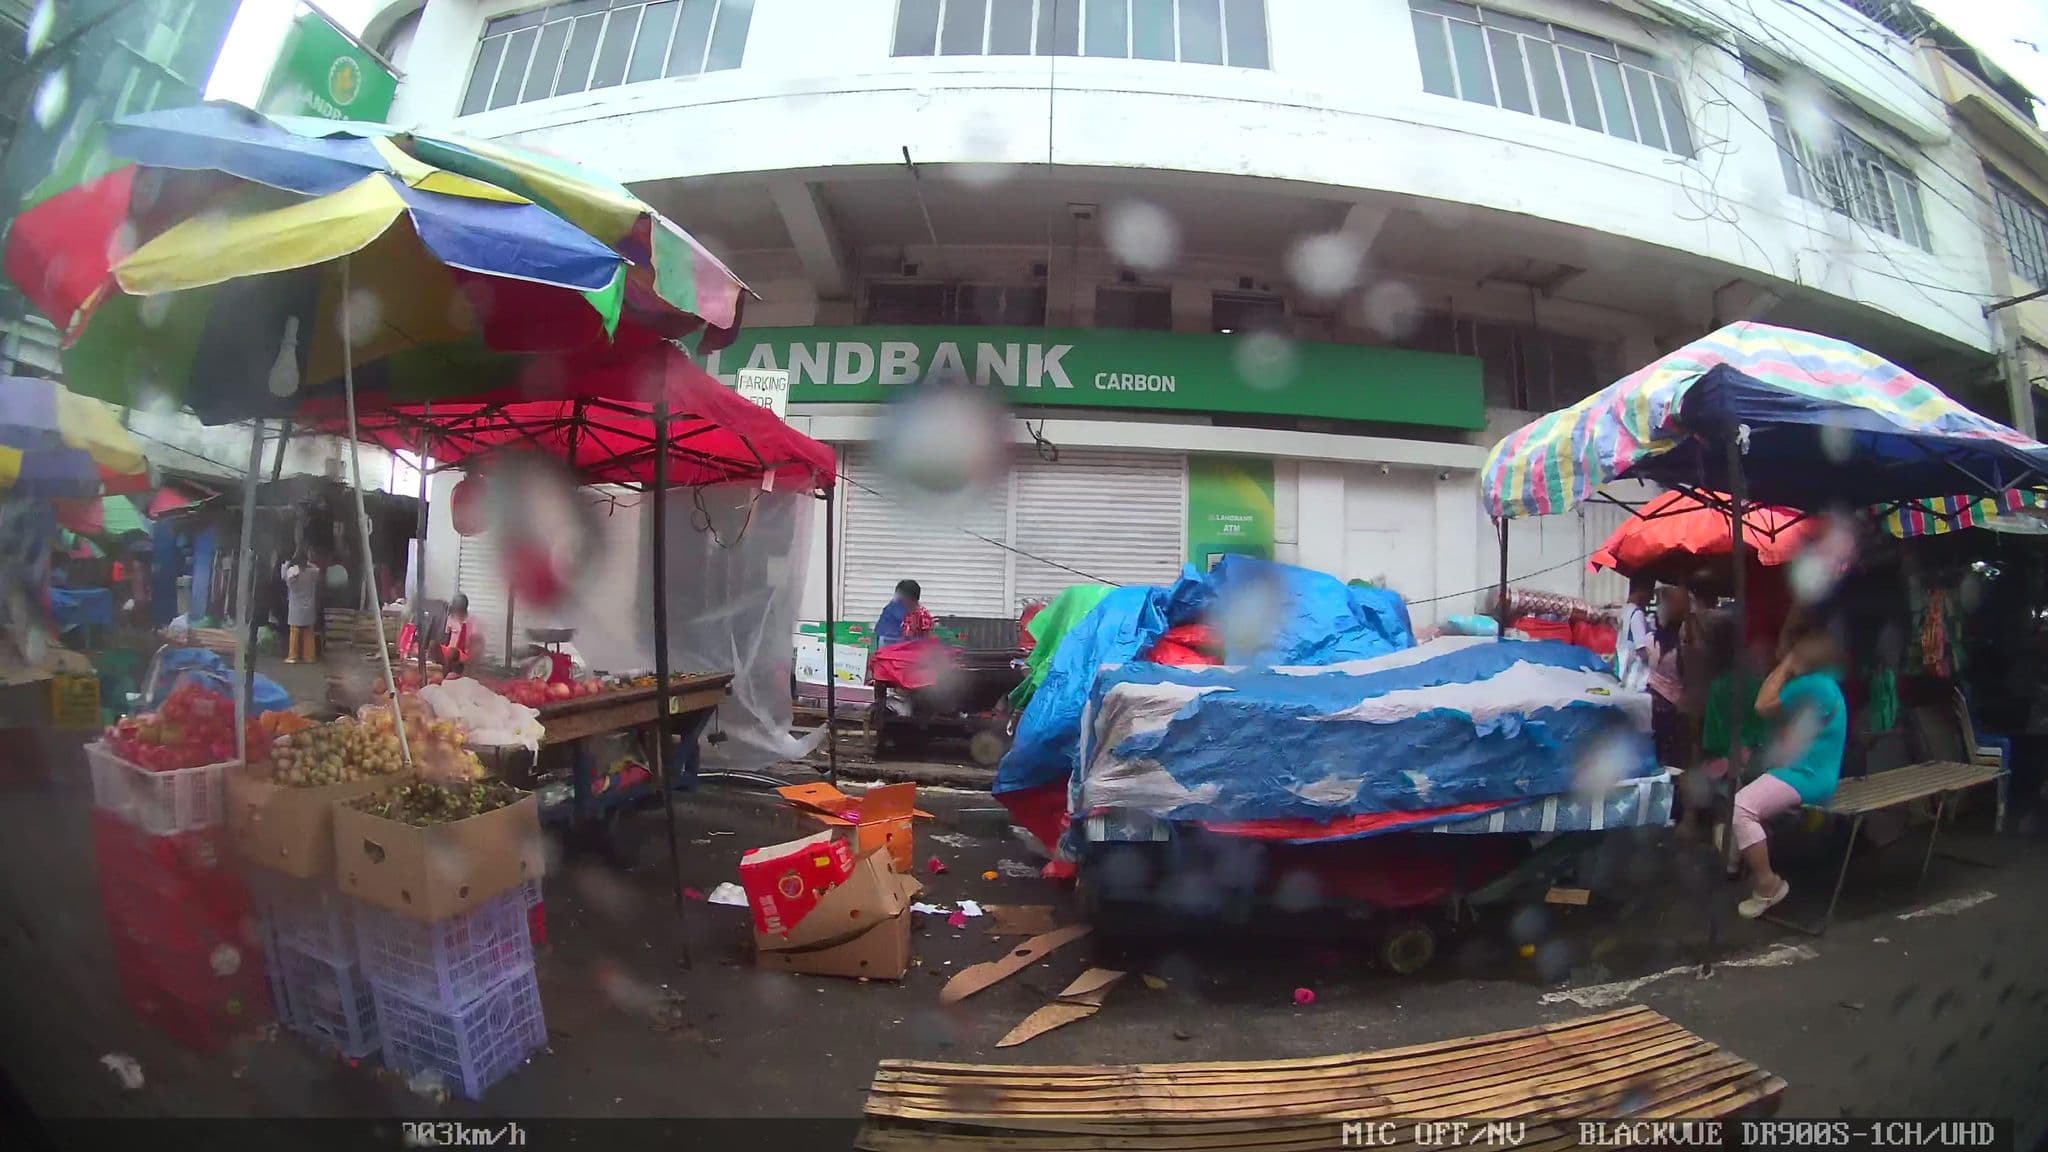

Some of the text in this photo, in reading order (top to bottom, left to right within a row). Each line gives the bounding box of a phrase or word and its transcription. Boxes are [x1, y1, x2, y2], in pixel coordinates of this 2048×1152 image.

[706, 342, 1175, 392] LANDBANK CARBON
[1223, 524, 1240, 532] ATM
